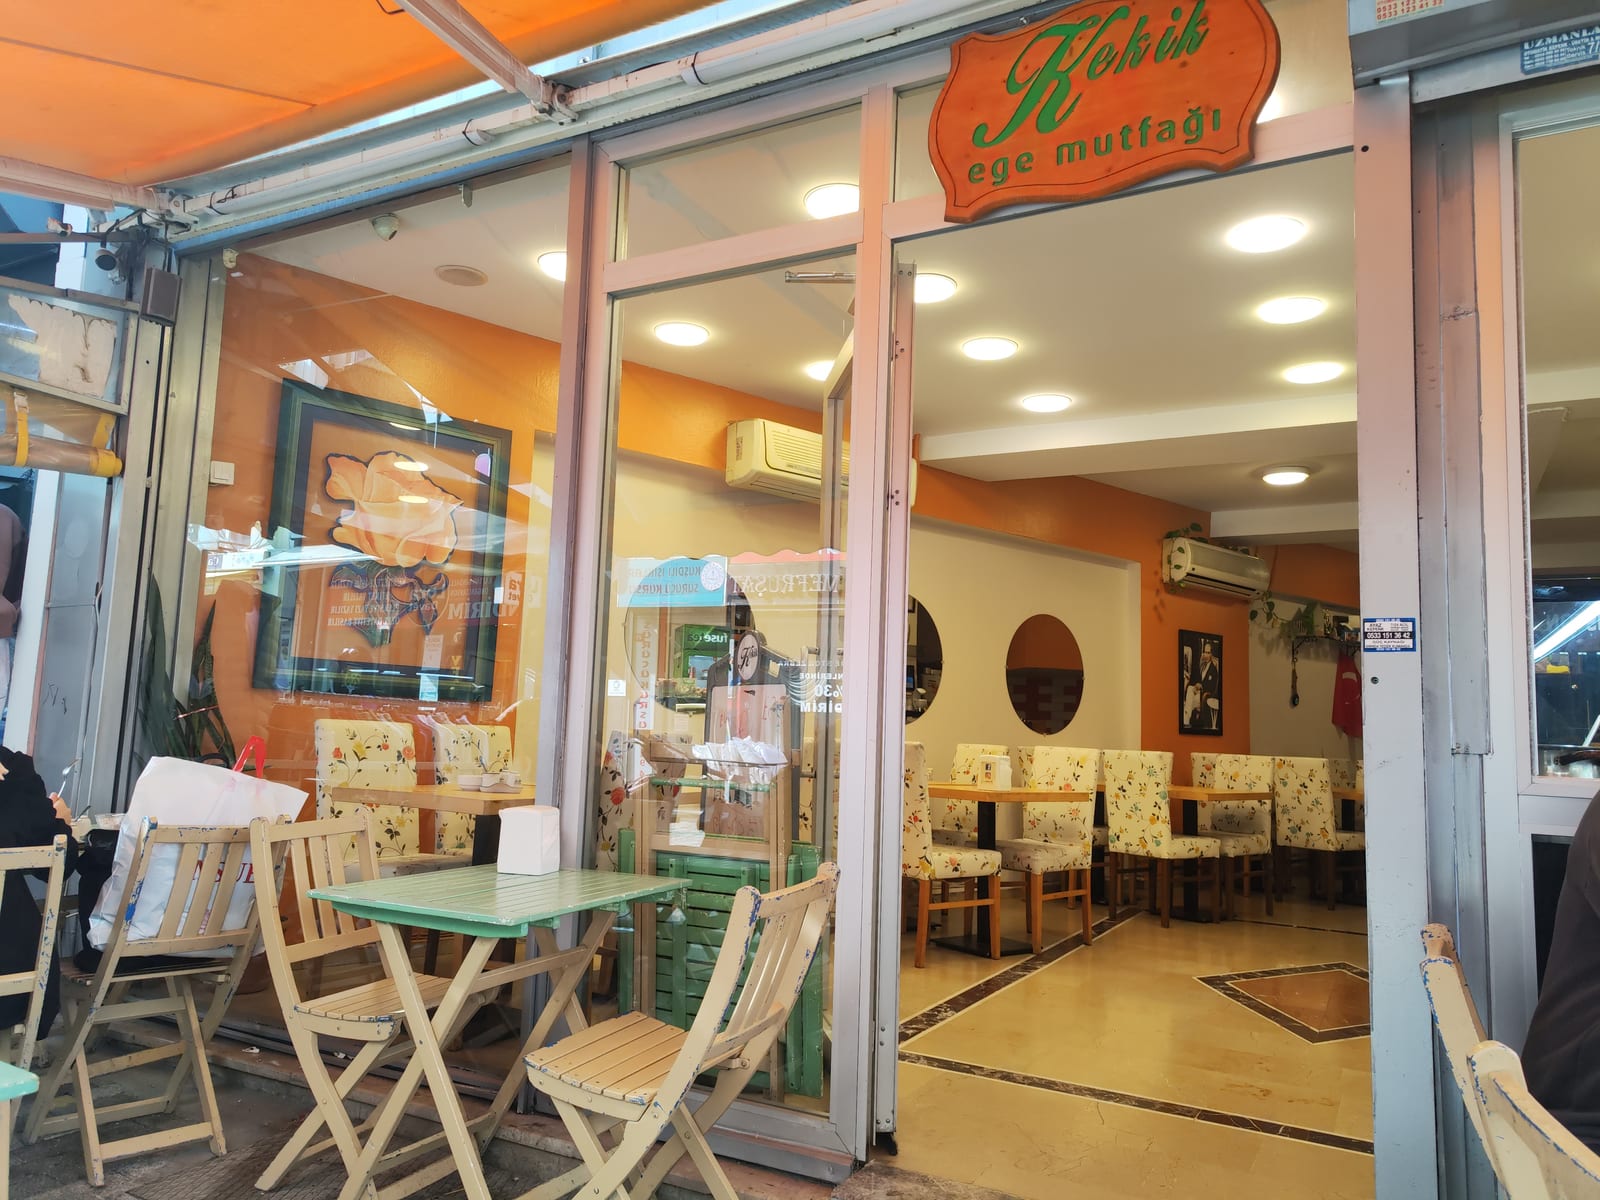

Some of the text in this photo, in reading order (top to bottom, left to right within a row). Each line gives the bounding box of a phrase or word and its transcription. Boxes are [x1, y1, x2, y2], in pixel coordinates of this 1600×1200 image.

[972, 1, 1210, 148] Kekik
[968, 106, 1222, 186] ege mutfağı
